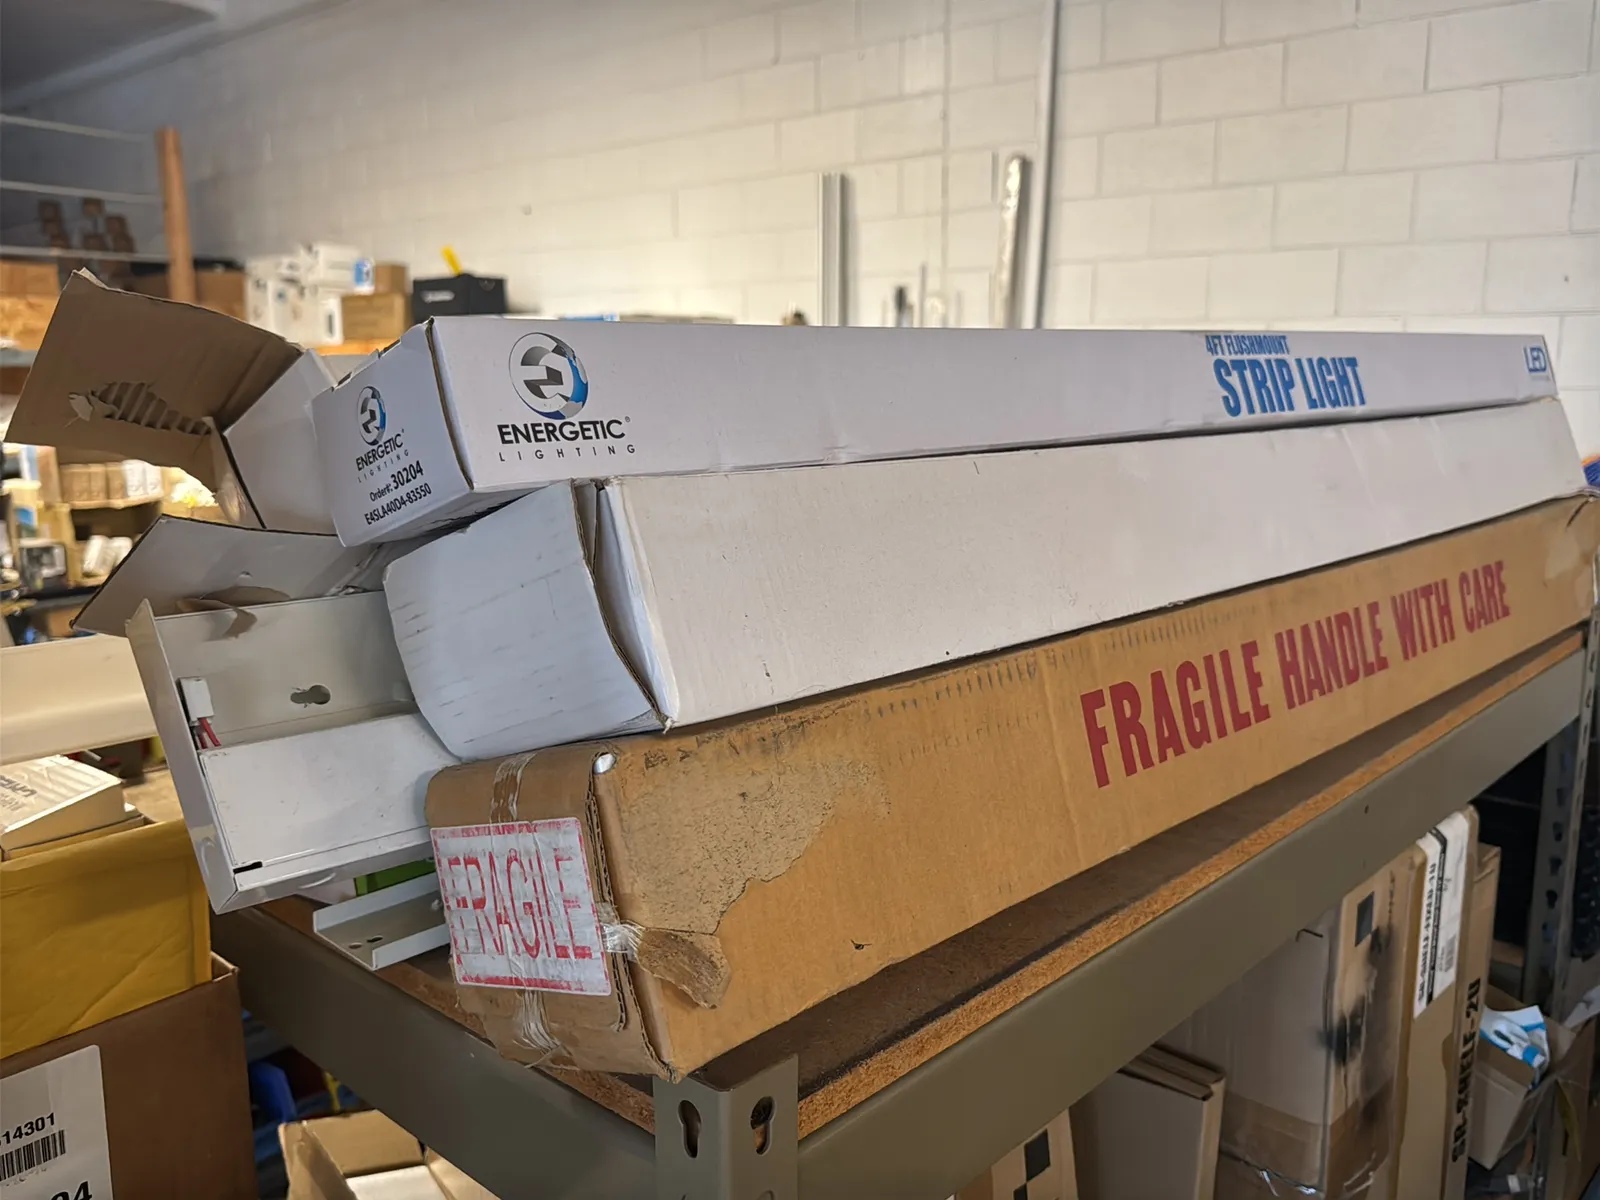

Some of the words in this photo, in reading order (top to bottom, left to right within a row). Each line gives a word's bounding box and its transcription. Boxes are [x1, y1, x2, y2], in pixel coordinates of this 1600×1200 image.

[1204, 335, 1224, 355] 4FT
[1223, 335, 1291, 357] FLUSHMOUNT
[1523, 346, 1548, 373] LED
[1212, 358, 1296, 417] STRIP
[1296, 357, 1367, 410] LIGHT
[357, 449, 410, 484] LIGHTING
[498, 443, 637, 462] LIGHTING
[390, 459, 424, 490] 30204
[1079, 640, 1271, 789] FRAGILE
[1274, 601, 1390, 710] HANDLE
[1391, 578, 1456, 661] WITH
[1458, 560, 1511, 633] CARE
[446, 847, 594, 961] FRAGILE
[0, 1112, 56, 1146] 14301
